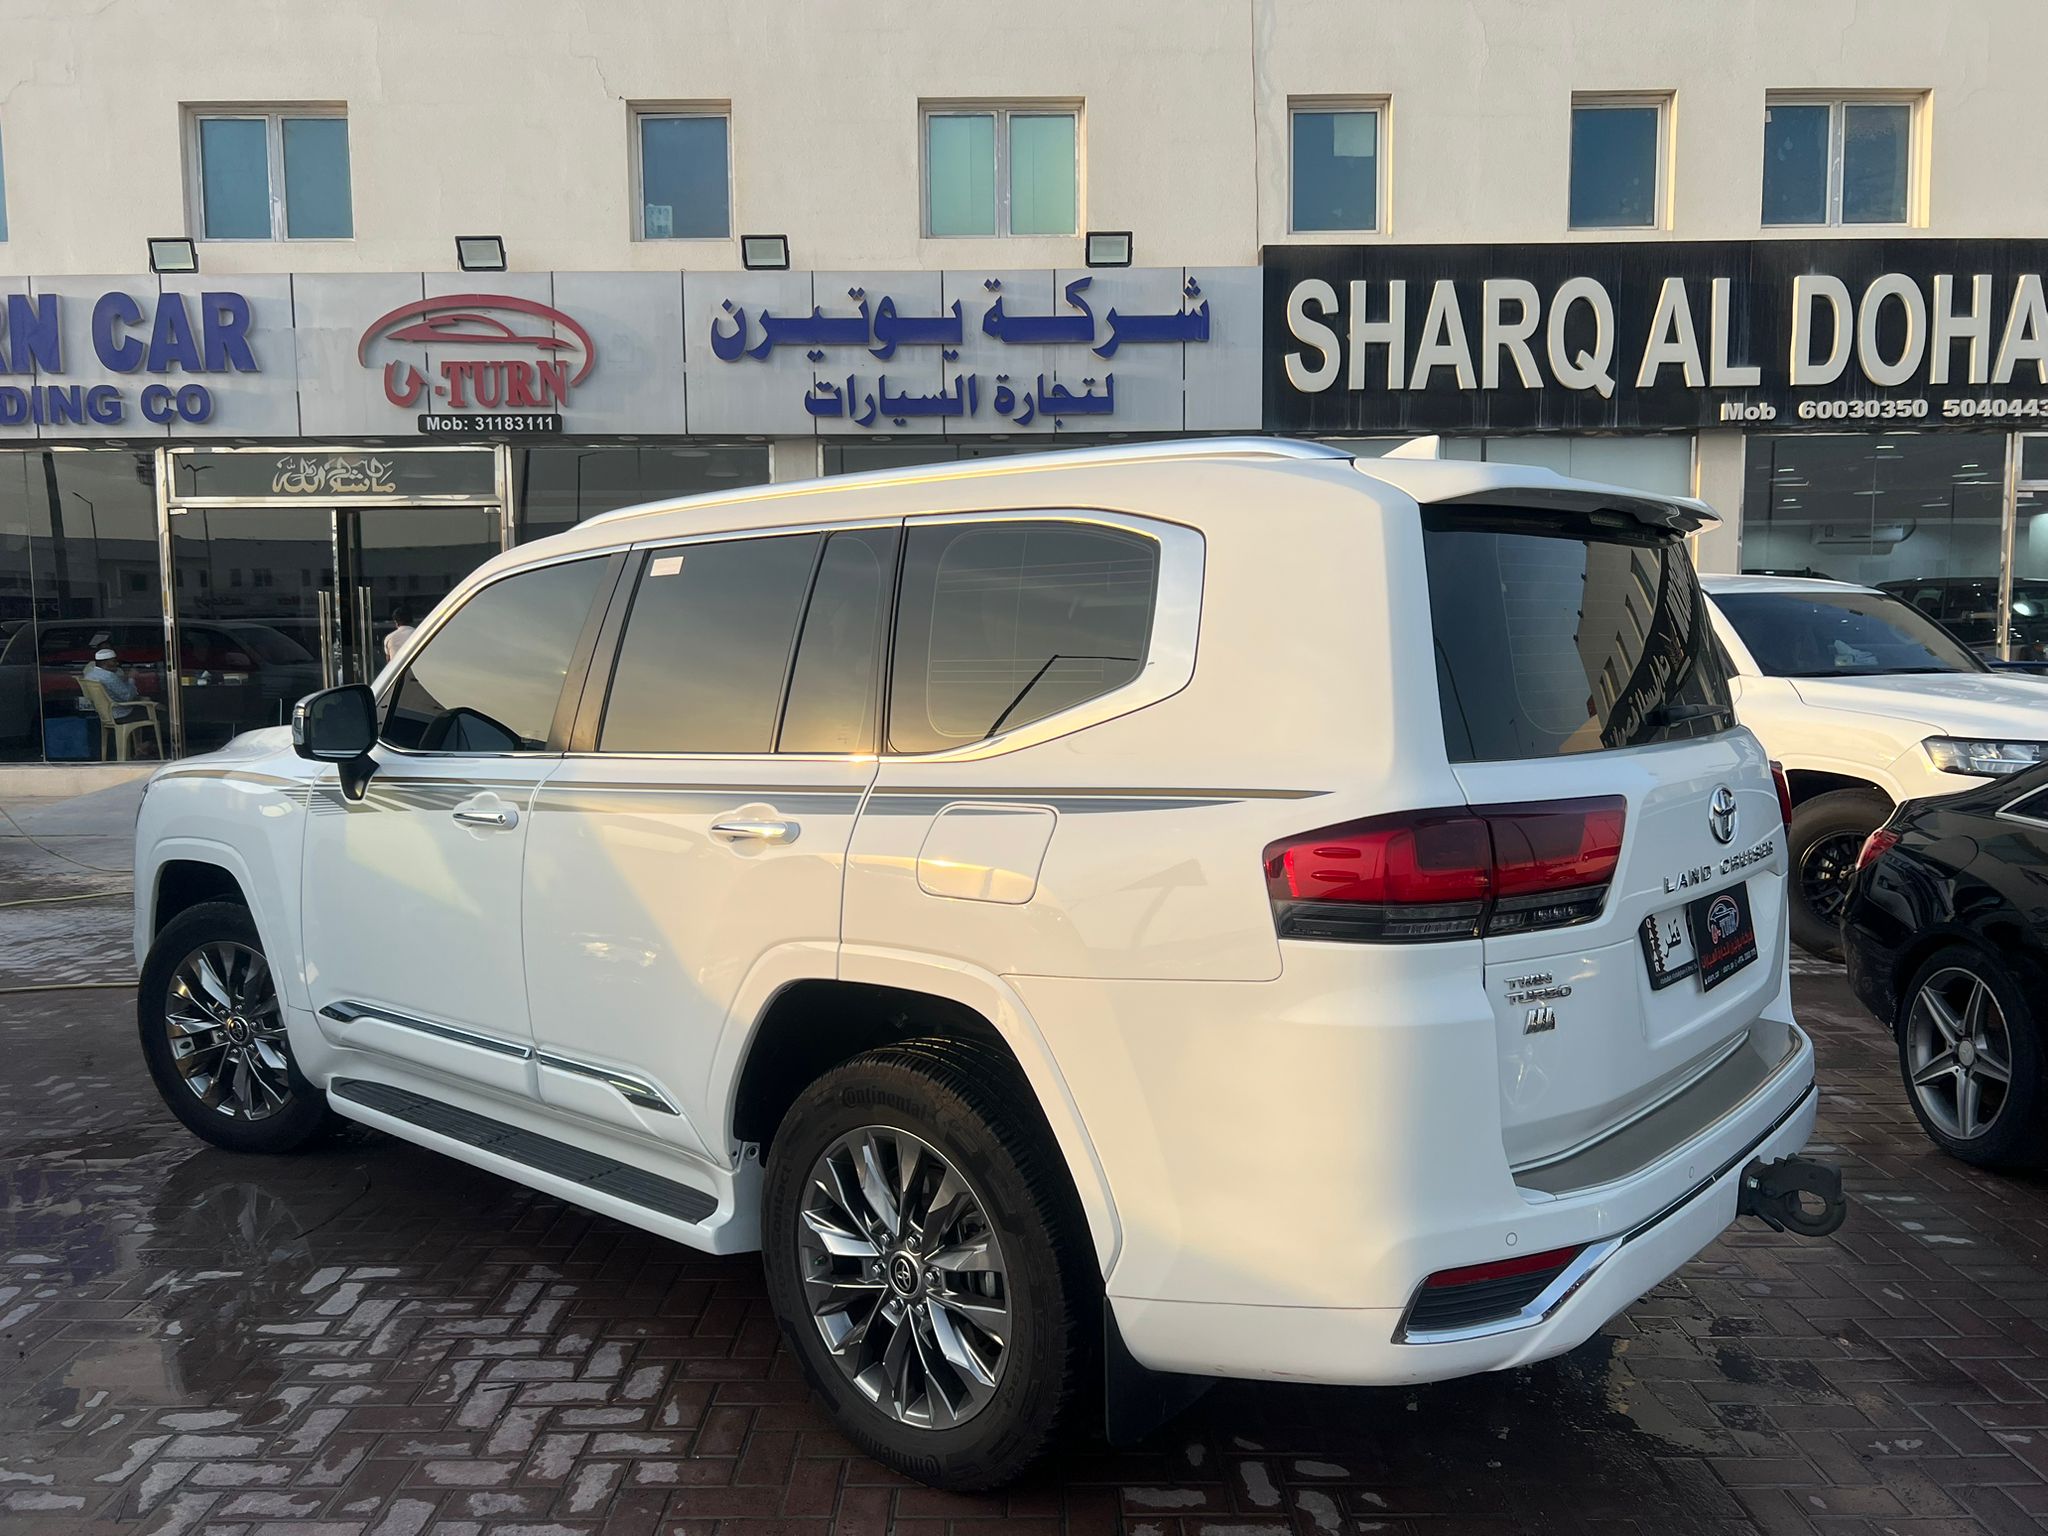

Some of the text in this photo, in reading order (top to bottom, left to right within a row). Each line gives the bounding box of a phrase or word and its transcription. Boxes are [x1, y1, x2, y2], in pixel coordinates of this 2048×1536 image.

[0, 291, 262, 375] N CAR
[710, 276, 1211, 362] شركة يوتيرن
[1284, 273, 2048, 399] SHARQ AL DOHA
[140, 384, 213, 425] CO
[426, 416, 553, 431] Mob: 31183111
[804, 373, 1115, 429] لتجارة السيارات
[1720, 401, 1776, 422] Mob
[1798, 400, 1929, 419] 60030350
[1663, 840, 1774, 895] LAND CRUISER
[1645, 918, 1661, 973] QATAR
[1664, 918, 1682, 958] قطر
[1504, 971, 1553, 990] TWIN
[1504, 984, 1572, 1006] TURBO
